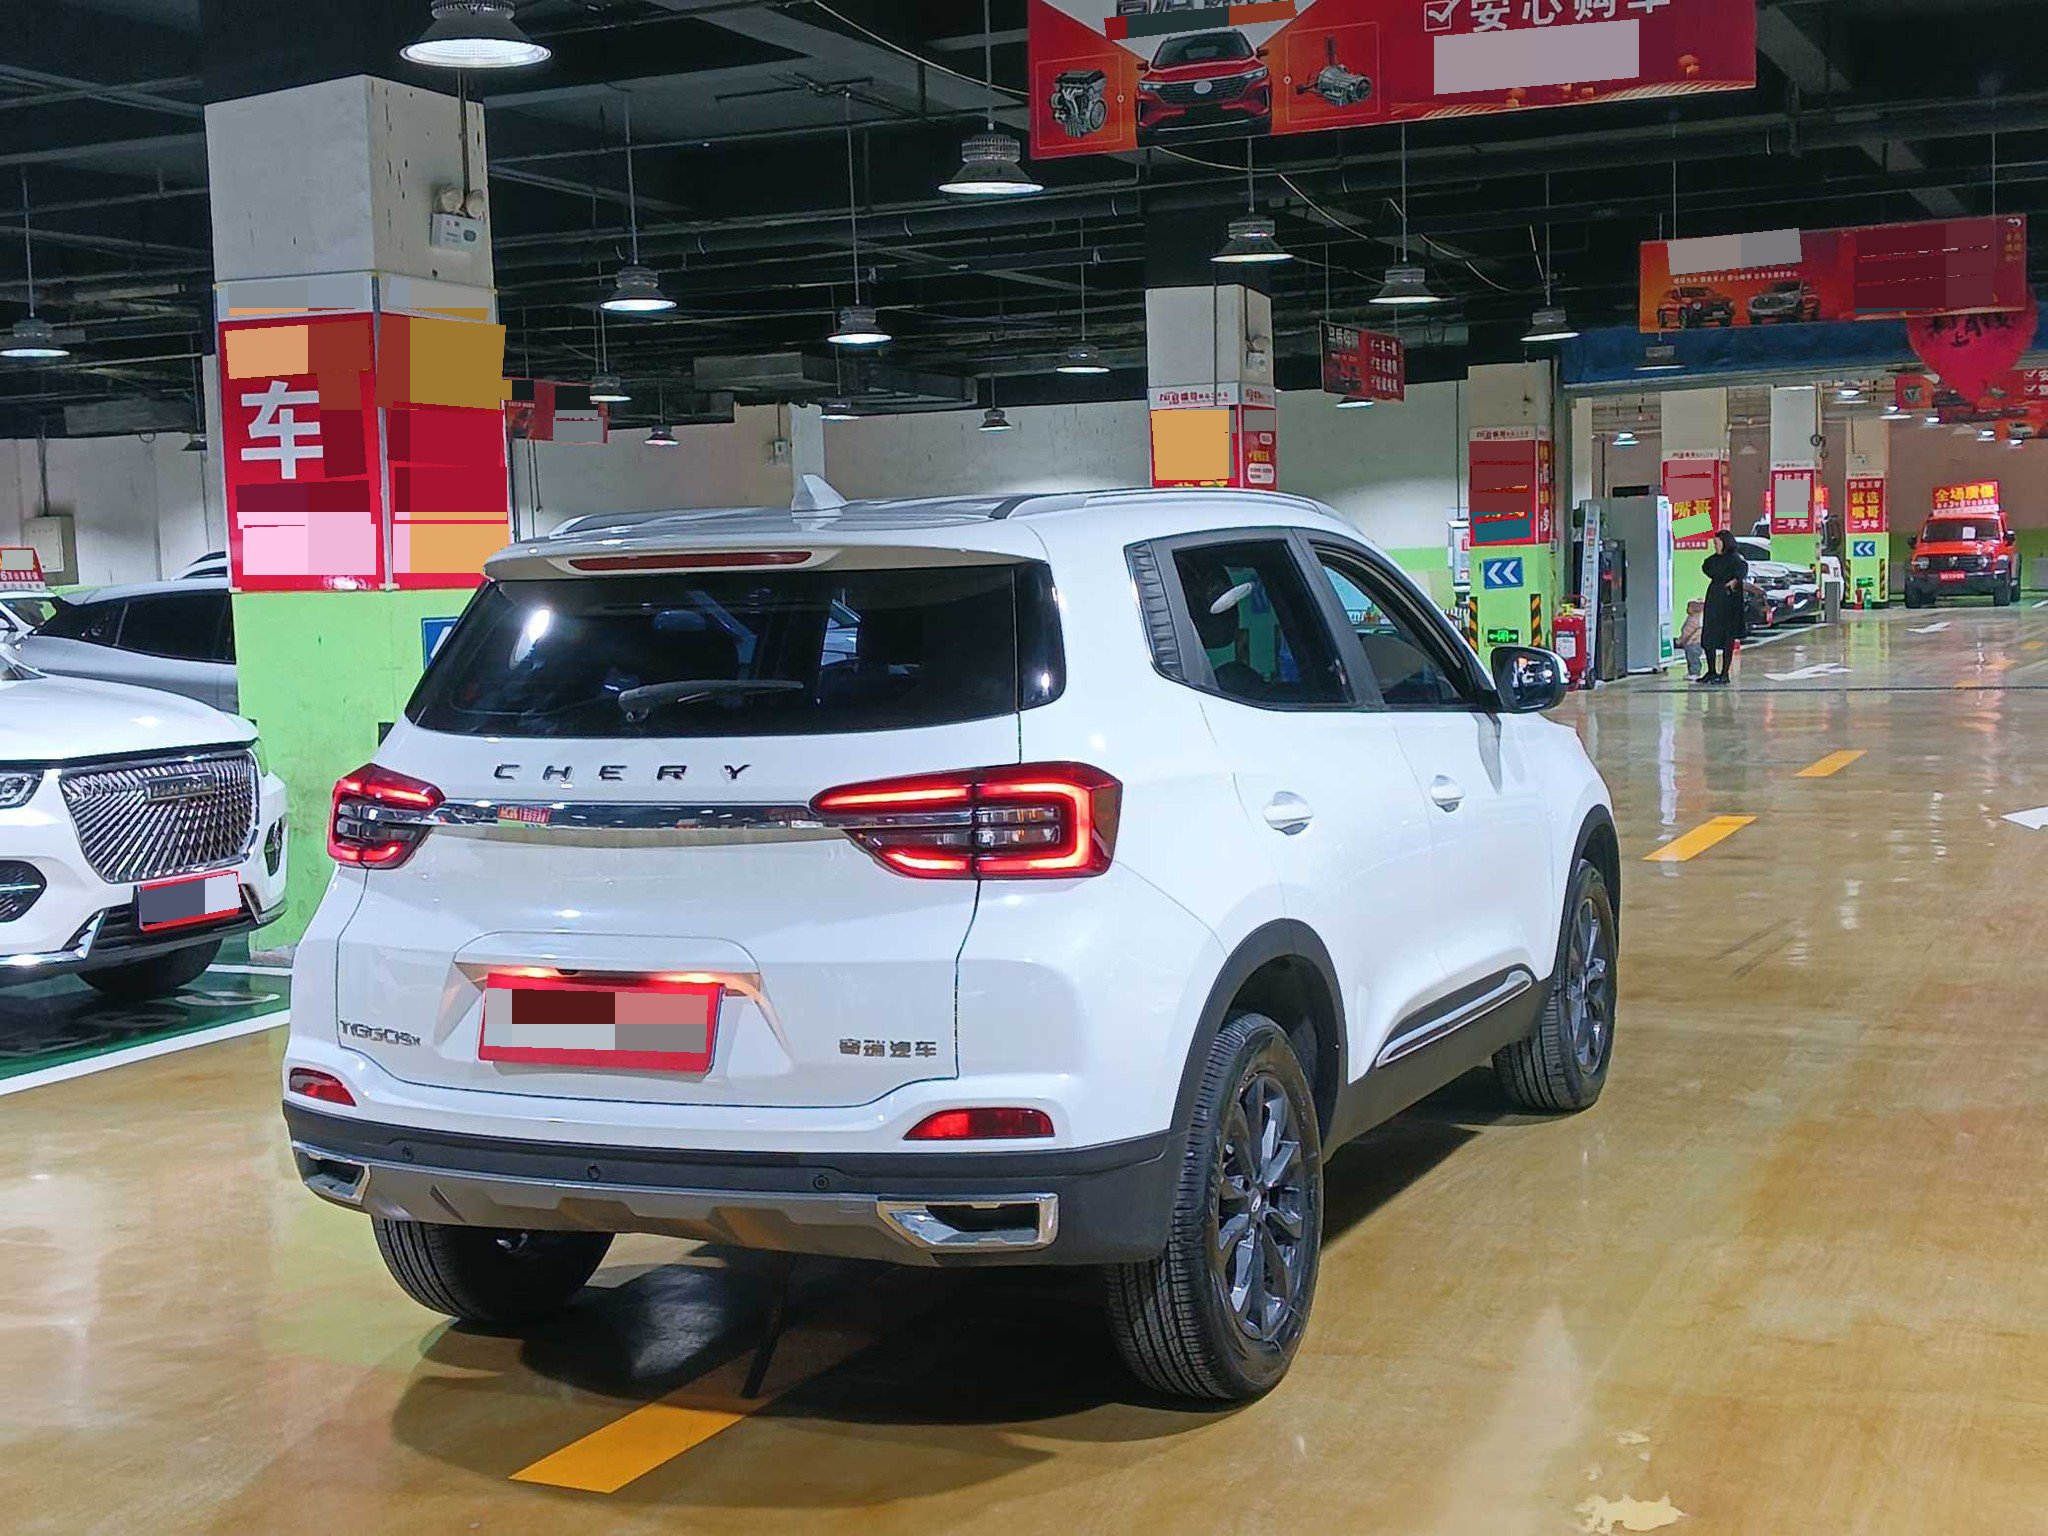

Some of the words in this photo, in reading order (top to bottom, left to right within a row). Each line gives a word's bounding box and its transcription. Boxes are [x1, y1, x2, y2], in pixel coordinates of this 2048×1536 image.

[241, 381, 323, 479] 车
[494, 764, 751, 781] CHERY
[840, 1039, 937, 1058] 奇瑞汽车
